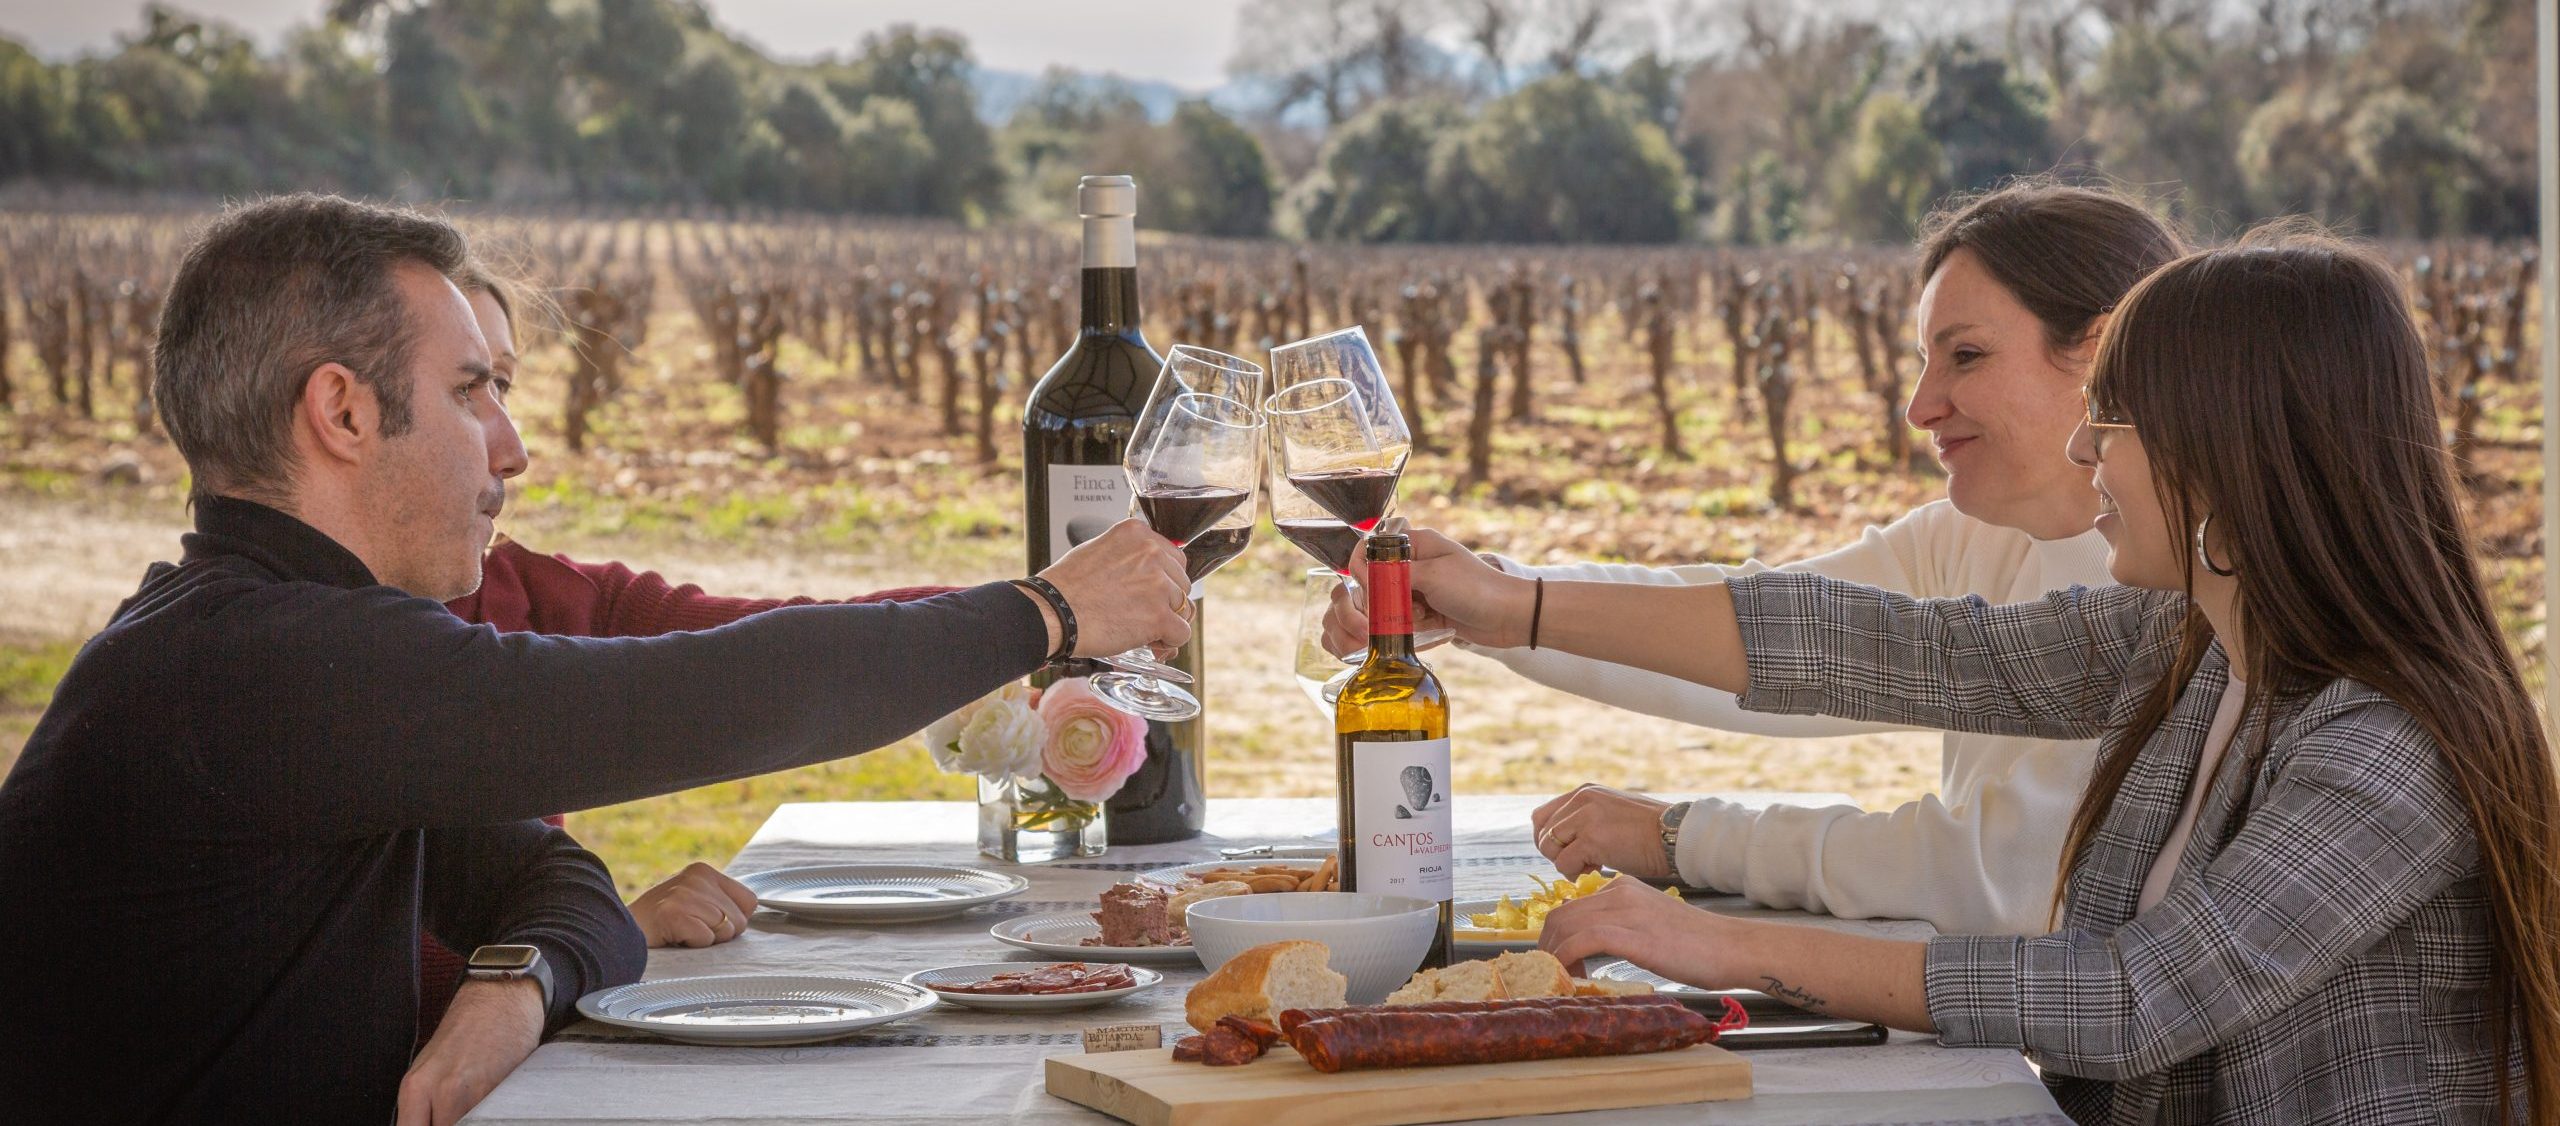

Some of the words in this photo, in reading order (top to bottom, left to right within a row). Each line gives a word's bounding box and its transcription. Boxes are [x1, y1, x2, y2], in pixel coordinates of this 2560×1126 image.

[1073, 475, 1115, 490] Finca
[1074, 494, 1113, 502] RESERVA
[1373, 832, 1433, 856] CANTOS
[1419, 865, 1442, 874] RIOJA
